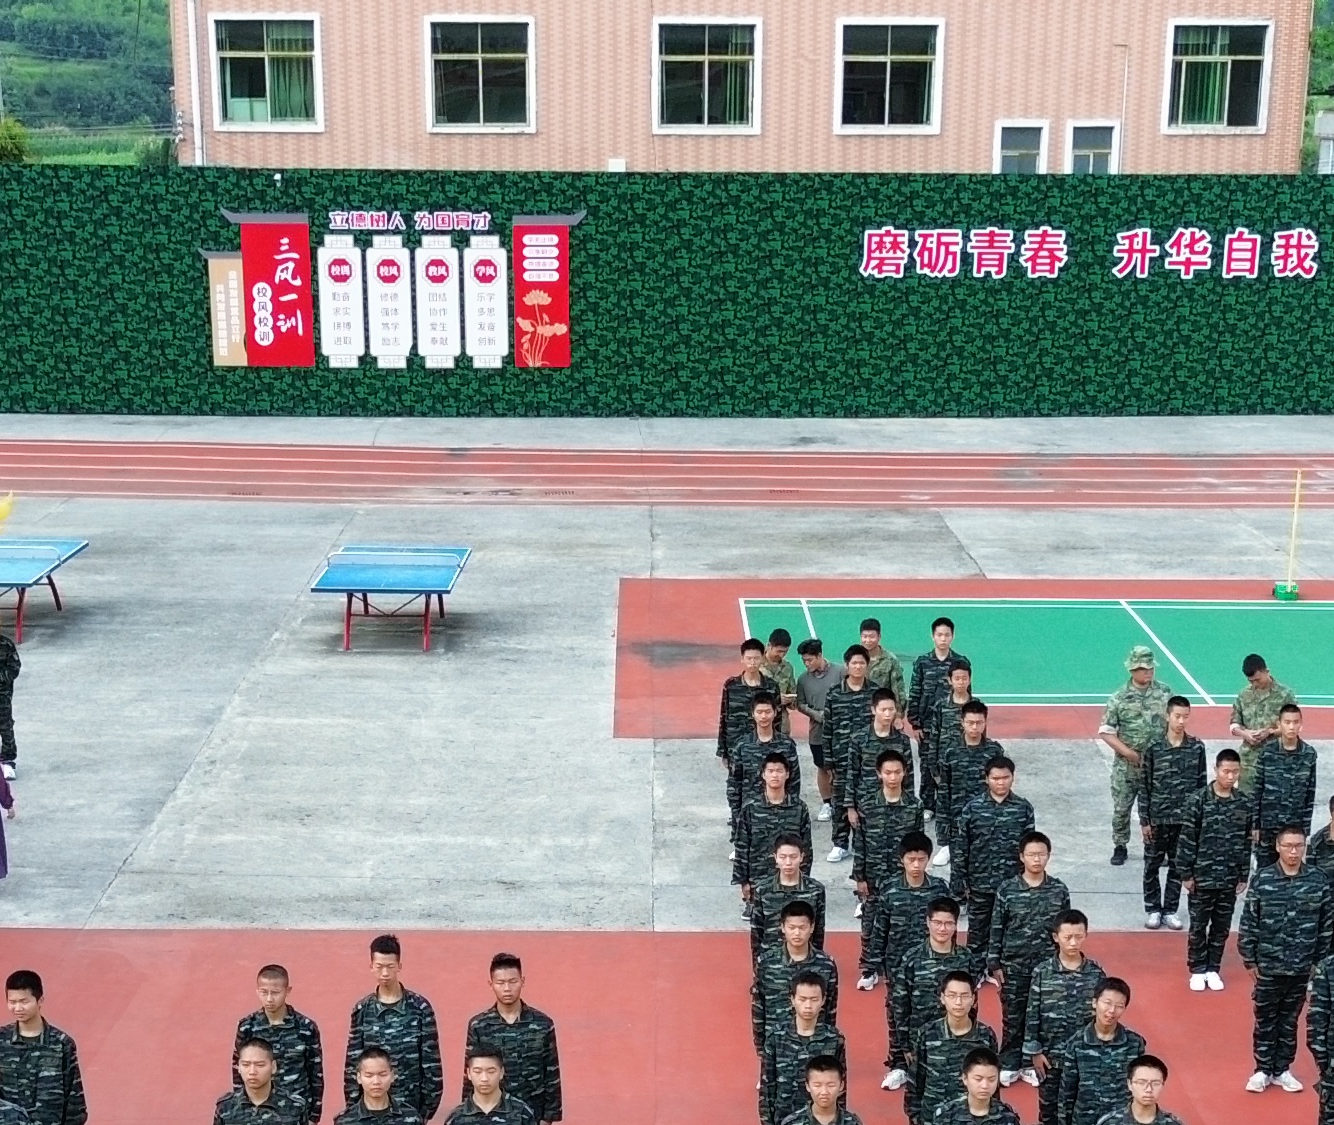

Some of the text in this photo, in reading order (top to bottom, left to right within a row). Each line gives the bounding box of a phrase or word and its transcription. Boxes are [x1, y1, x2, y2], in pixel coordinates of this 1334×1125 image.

[329, 211, 491, 230] 立德树人 为国育才
[860, 227, 1319, 279] 磨砺青春 升华自我
[427, 265, 448, 277] 教风
[475, 265, 496, 277] 学风
[273, 237, 303, 337] 三风一训
[428, 292, 447, 302] 团结
[255, 285, 271, 343] 校风校训
